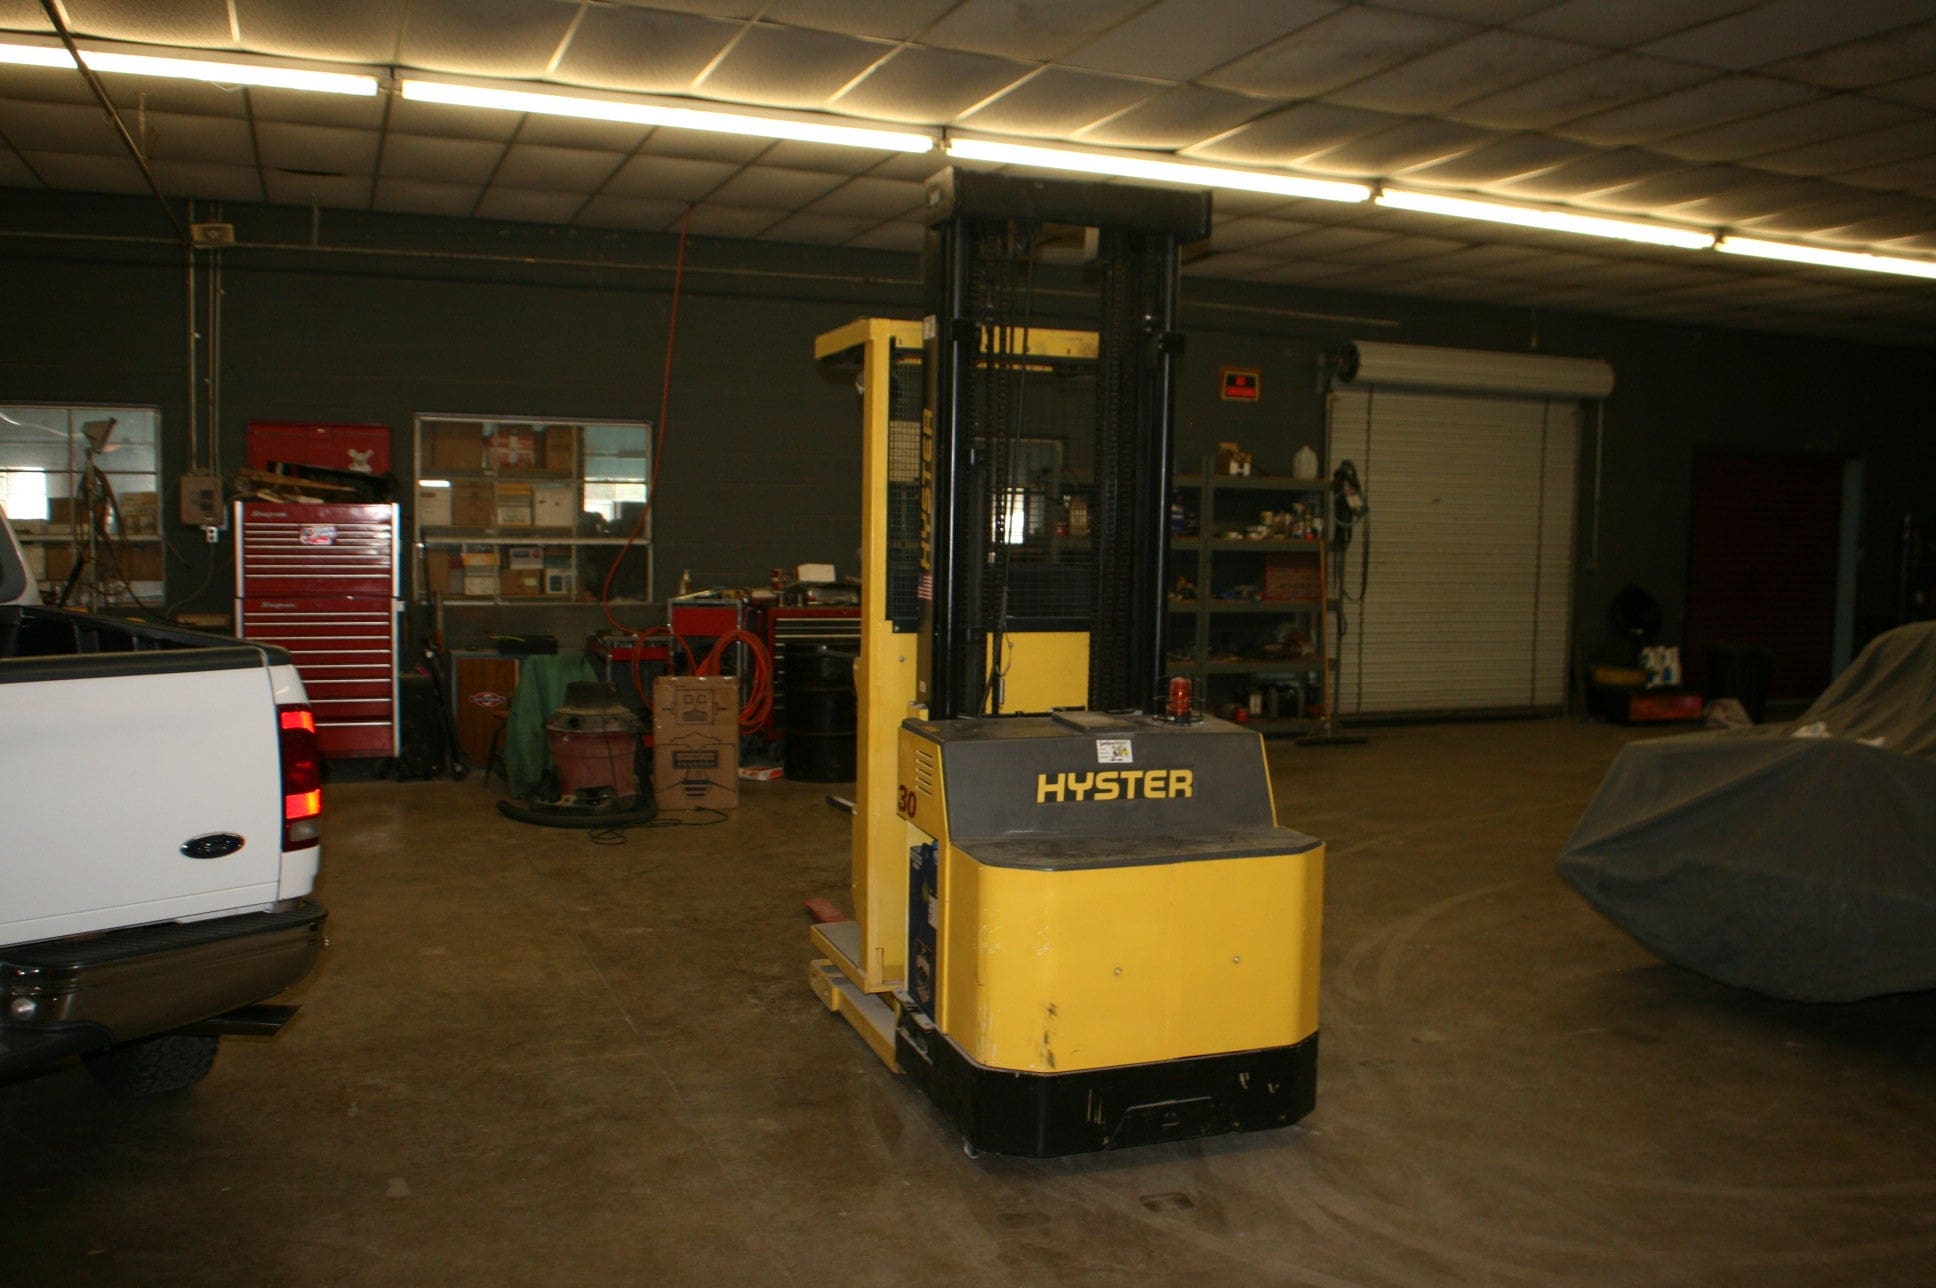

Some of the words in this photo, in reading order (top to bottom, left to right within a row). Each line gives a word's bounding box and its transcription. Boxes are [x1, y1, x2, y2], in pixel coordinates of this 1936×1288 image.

[920, 408, 933, 571] HYSTER
[898, 784, 917, 819] 30
[1036, 769, 1194, 803] HYSTER
